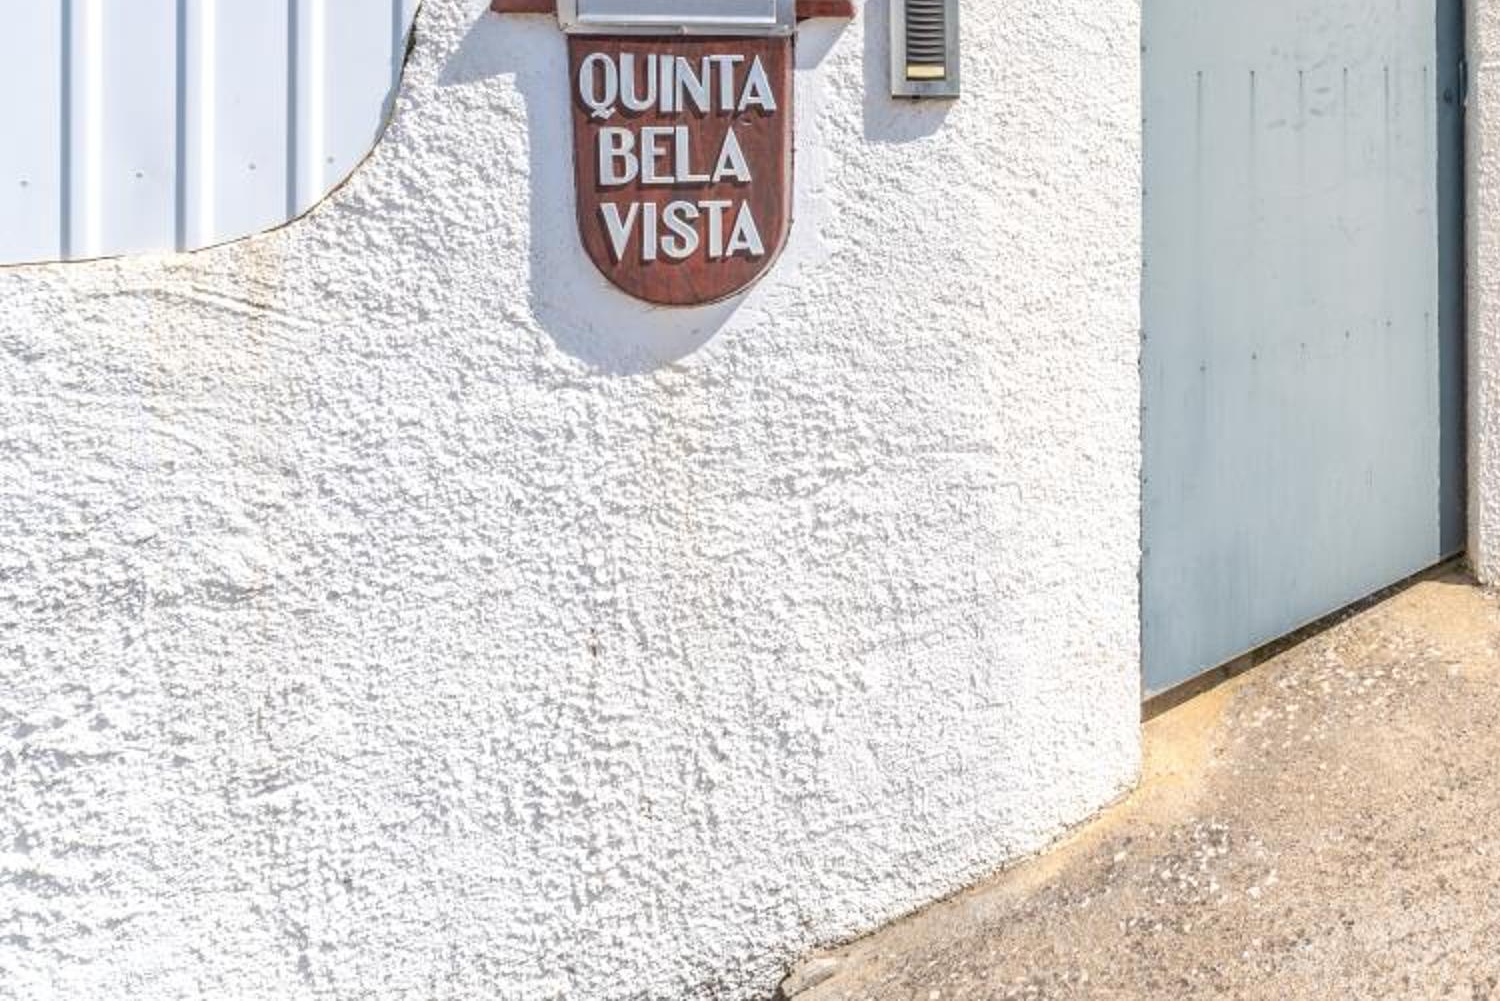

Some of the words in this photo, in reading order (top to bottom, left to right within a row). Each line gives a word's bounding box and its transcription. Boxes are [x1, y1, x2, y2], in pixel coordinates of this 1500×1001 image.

[579, 53, 777, 118] QUINTA
[598, 126, 752, 186] BELA
[600, 199, 765, 261] VISTA
